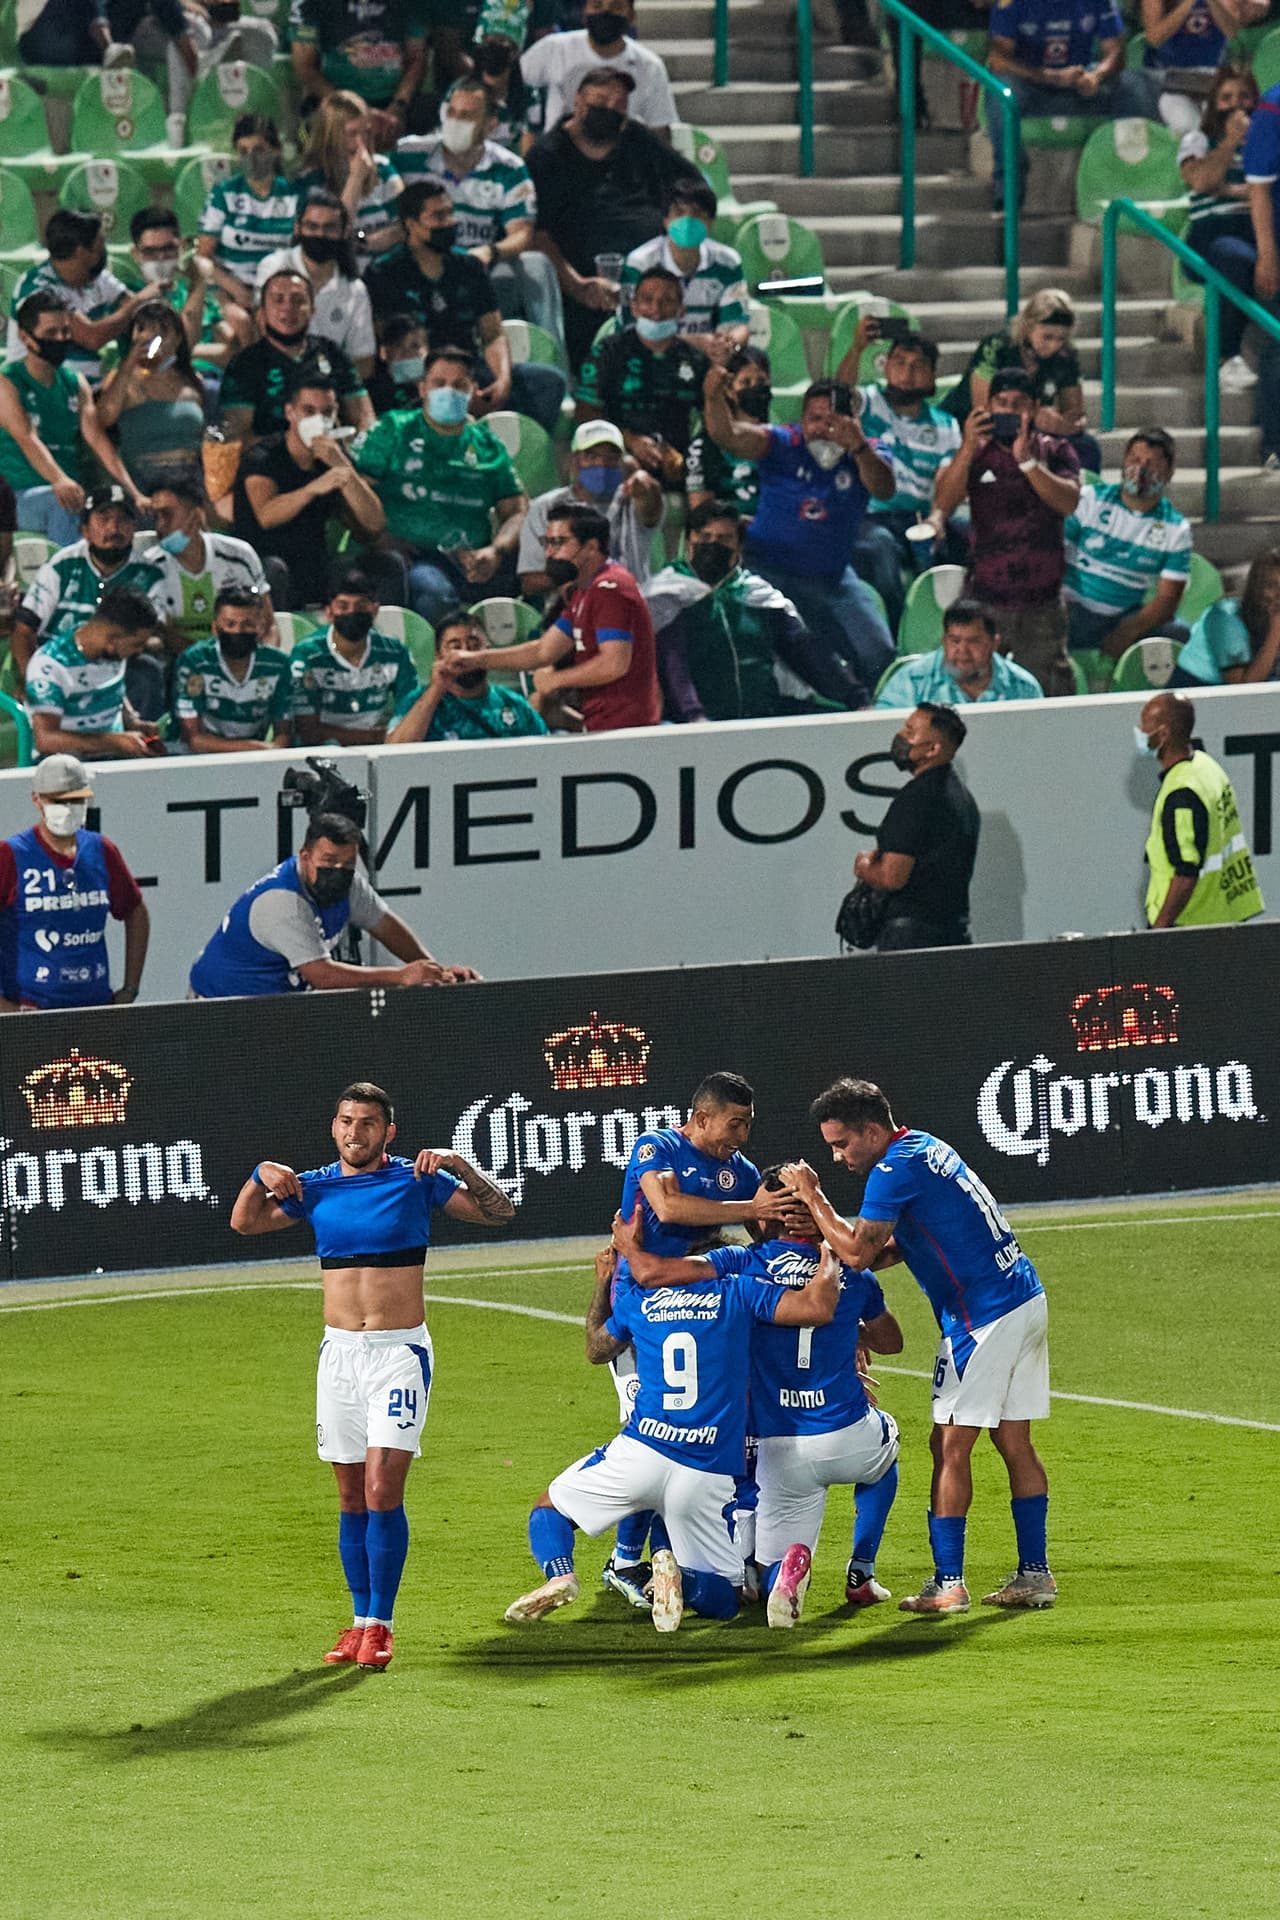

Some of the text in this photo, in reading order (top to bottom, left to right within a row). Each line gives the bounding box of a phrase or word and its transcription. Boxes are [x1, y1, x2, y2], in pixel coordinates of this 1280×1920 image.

[23, 868, 56, 894] 21
[976, 1054, 1257, 1167] Corona
[0, 1137, 211, 1214] orona
[641, 1287, 722, 1315] Caliente
[647, 1308, 718, 1322] caliente.mx
[662, 1332, 698, 1410] 9
[388, 1388, 417, 1419] 24
[779, 1388, 826, 1409] ROMO
[638, 1417, 718, 1445] MONTOYA
